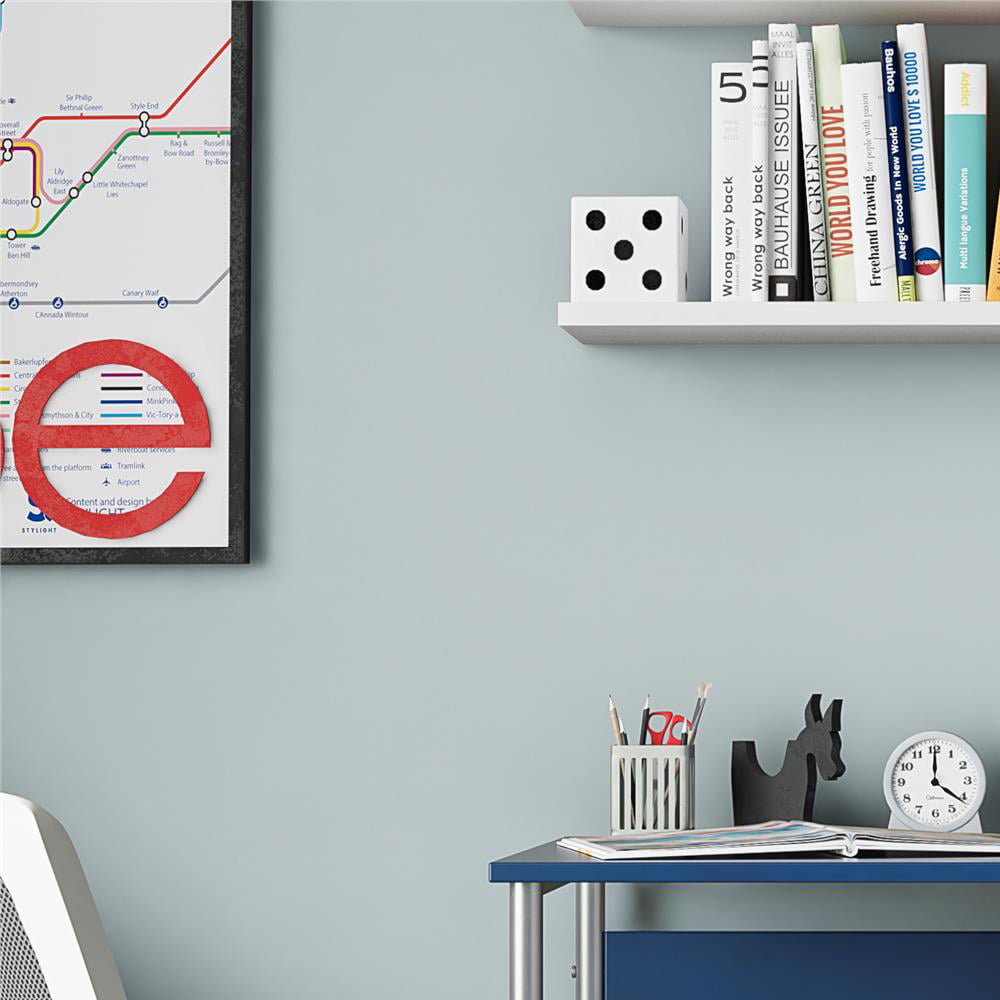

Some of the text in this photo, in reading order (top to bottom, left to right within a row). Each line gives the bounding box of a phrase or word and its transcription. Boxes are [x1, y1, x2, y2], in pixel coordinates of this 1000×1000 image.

[884, 48, 896, 93] Bauhos
[719, 72, 747, 103] 5
[961, 72, 970, 107] Addict
[76, 94, 92, 102] Philip
[904, 52, 927, 192] WORLD YOU LOVE 10000
[889, 126, 900, 155] World
[54, 168, 64, 176] Lily
[774, 80, 789, 269] BAUHAUSE ISSUEE
[110, 181, 148, 190] Whitechapel
[821, 105, 854, 258] WORLD YOU LOVE
[895, 194, 904, 224] Goods
[805, 144, 829, 296] CHINA GREEN
[960, 167, 971, 269] Multi langue Variations
[752, 165, 766, 292] Wrong way back
[863, 175, 882, 286] Freehand Drawing
[723, 176, 735, 296] Wrong way back
[897, 226, 908, 260] Alergic
[64, 464, 91, 472] platform
[117, 498, 144, 507] design
[912, 750, 922, 759] 11
[949, 750, 953, 758] 1
[901, 762, 913, 771] 10
[959, 761, 967, 770] 2
[897, 778, 906, 787] 9
[963, 776, 972, 785] 3
[903, 794, 911, 803] 8
[915, 805, 923, 814] 7
[948, 804, 956, 813] 5
[932, 809, 939, 818] 6
